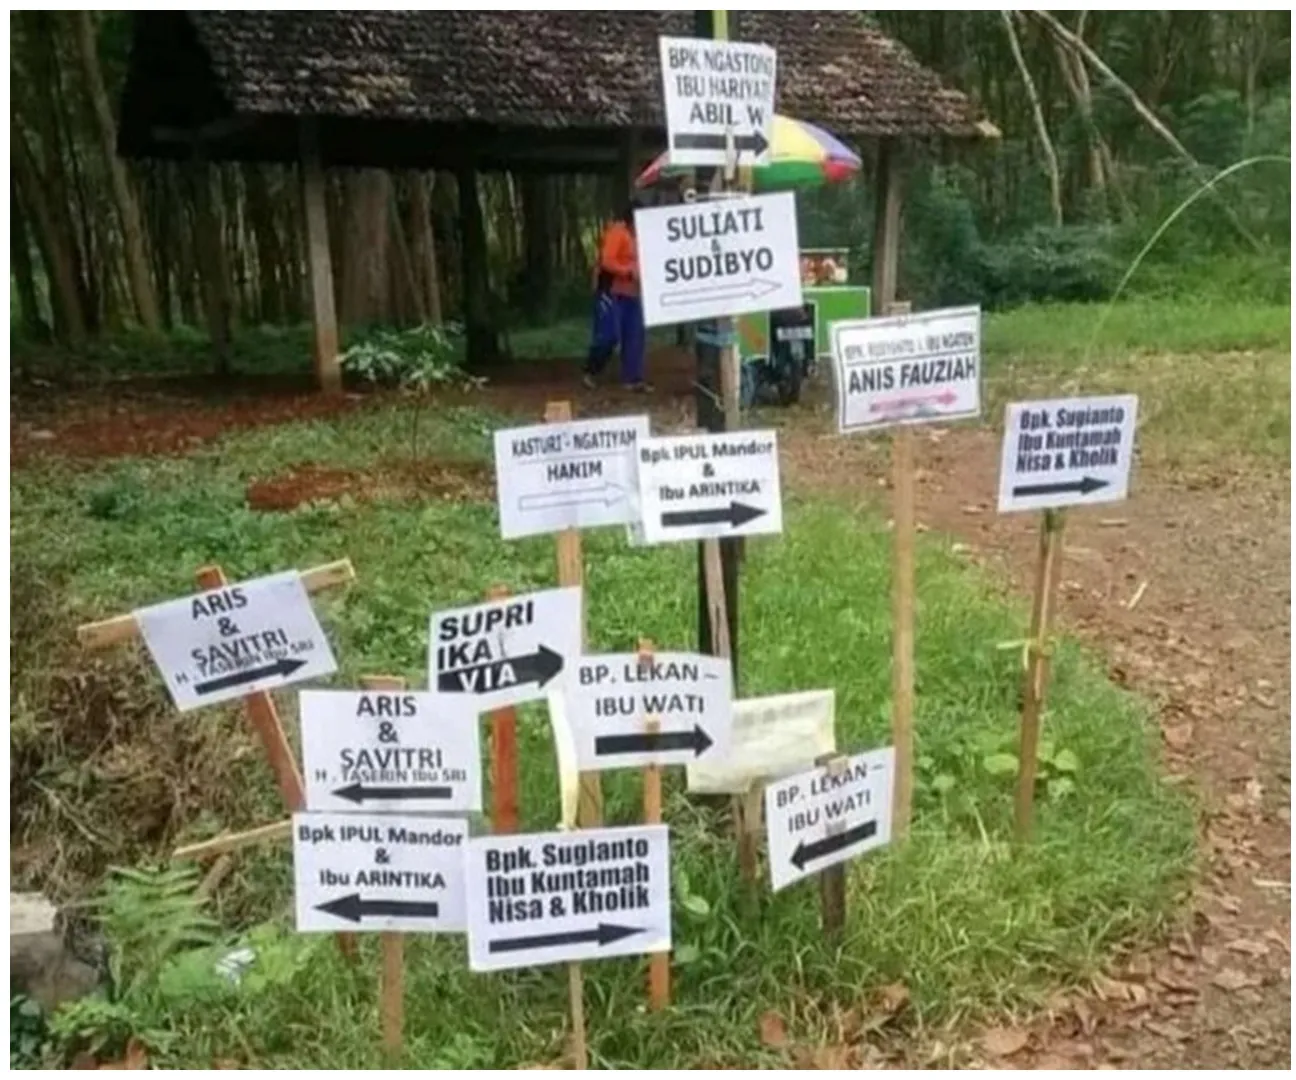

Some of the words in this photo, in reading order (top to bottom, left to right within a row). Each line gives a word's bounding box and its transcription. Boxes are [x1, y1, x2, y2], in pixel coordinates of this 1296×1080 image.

[668, 47, 700, 70] BPK
[676, 75, 706, 98] IBU
[747, 105, 764, 127] W
[667, 206, 764, 242] SULIATI
[664, 246, 773, 283] SUDIBYO
[849, 365, 894, 394] ANIS
[900, 357, 976, 388] FAUZIAH
[1056, 405, 1125, 429] Sugianto
[511, 434, 562, 457] KASTURI
[573, 428, 637, 449] NGATIYAM
[674, 444, 708, 460] IPUL
[712, 440, 773, 457] Mandor
[1018, 432, 1043, 452] Ibu
[1046, 426, 1121, 450] Kuntamah
[547, 460, 602, 482] HANIM
[703, 462, 715, 478] &
[1016, 453, 1051, 473] Nisa
[1055, 452, 1065, 470] &
[1069, 447, 1118, 468] Kholik
[659, 484, 685, 501] Ibu
[689, 479, 760, 498] ARINTIKA
[192, 588, 248, 620] ARIS
[217, 617, 241, 637] &
[439, 600, 534, 641] SUPRI
[191, 628, 289, 667] SAVITRI
[438, 638, 493, 670] IKA
[459, 662, 517, 692] VIA
[579, 664, 617, 685] BP.
[624, 662, 699, 683] LEKAN
[356, 695, 417, 717] ARIS
[595, 695, 635, 717] IBU
[643, 693, 704, 714] WATI
[378, 721, 399, 744] &
[340, 748, 442, 770] SAVITRI
[811, 762, 867, 796] LEKAN
[788, 806, 820, 834] IBU
[825, 789, 870, 819] WATI
[299, 825, 335, 844] Bpk
[340, 826, 384, 842] IPUL
[388, 827, 463, 846] Mandor
[375, 847, 390, 864] &
[485, 847, 538, 874] Bpk.
[542, 838, 649, 867] Sugianto
[319, 869, 350, 886] Ibu
[355, 870, 446, 888] ARINTIKA
[487, 875, 525, 899] Ibu
[531, 861, 649, 894] Kuntamah
[488, 898, 544, 925] Nisa
[549, 896, 566, 918] &
[573, 884, 649, 915] Kholik
